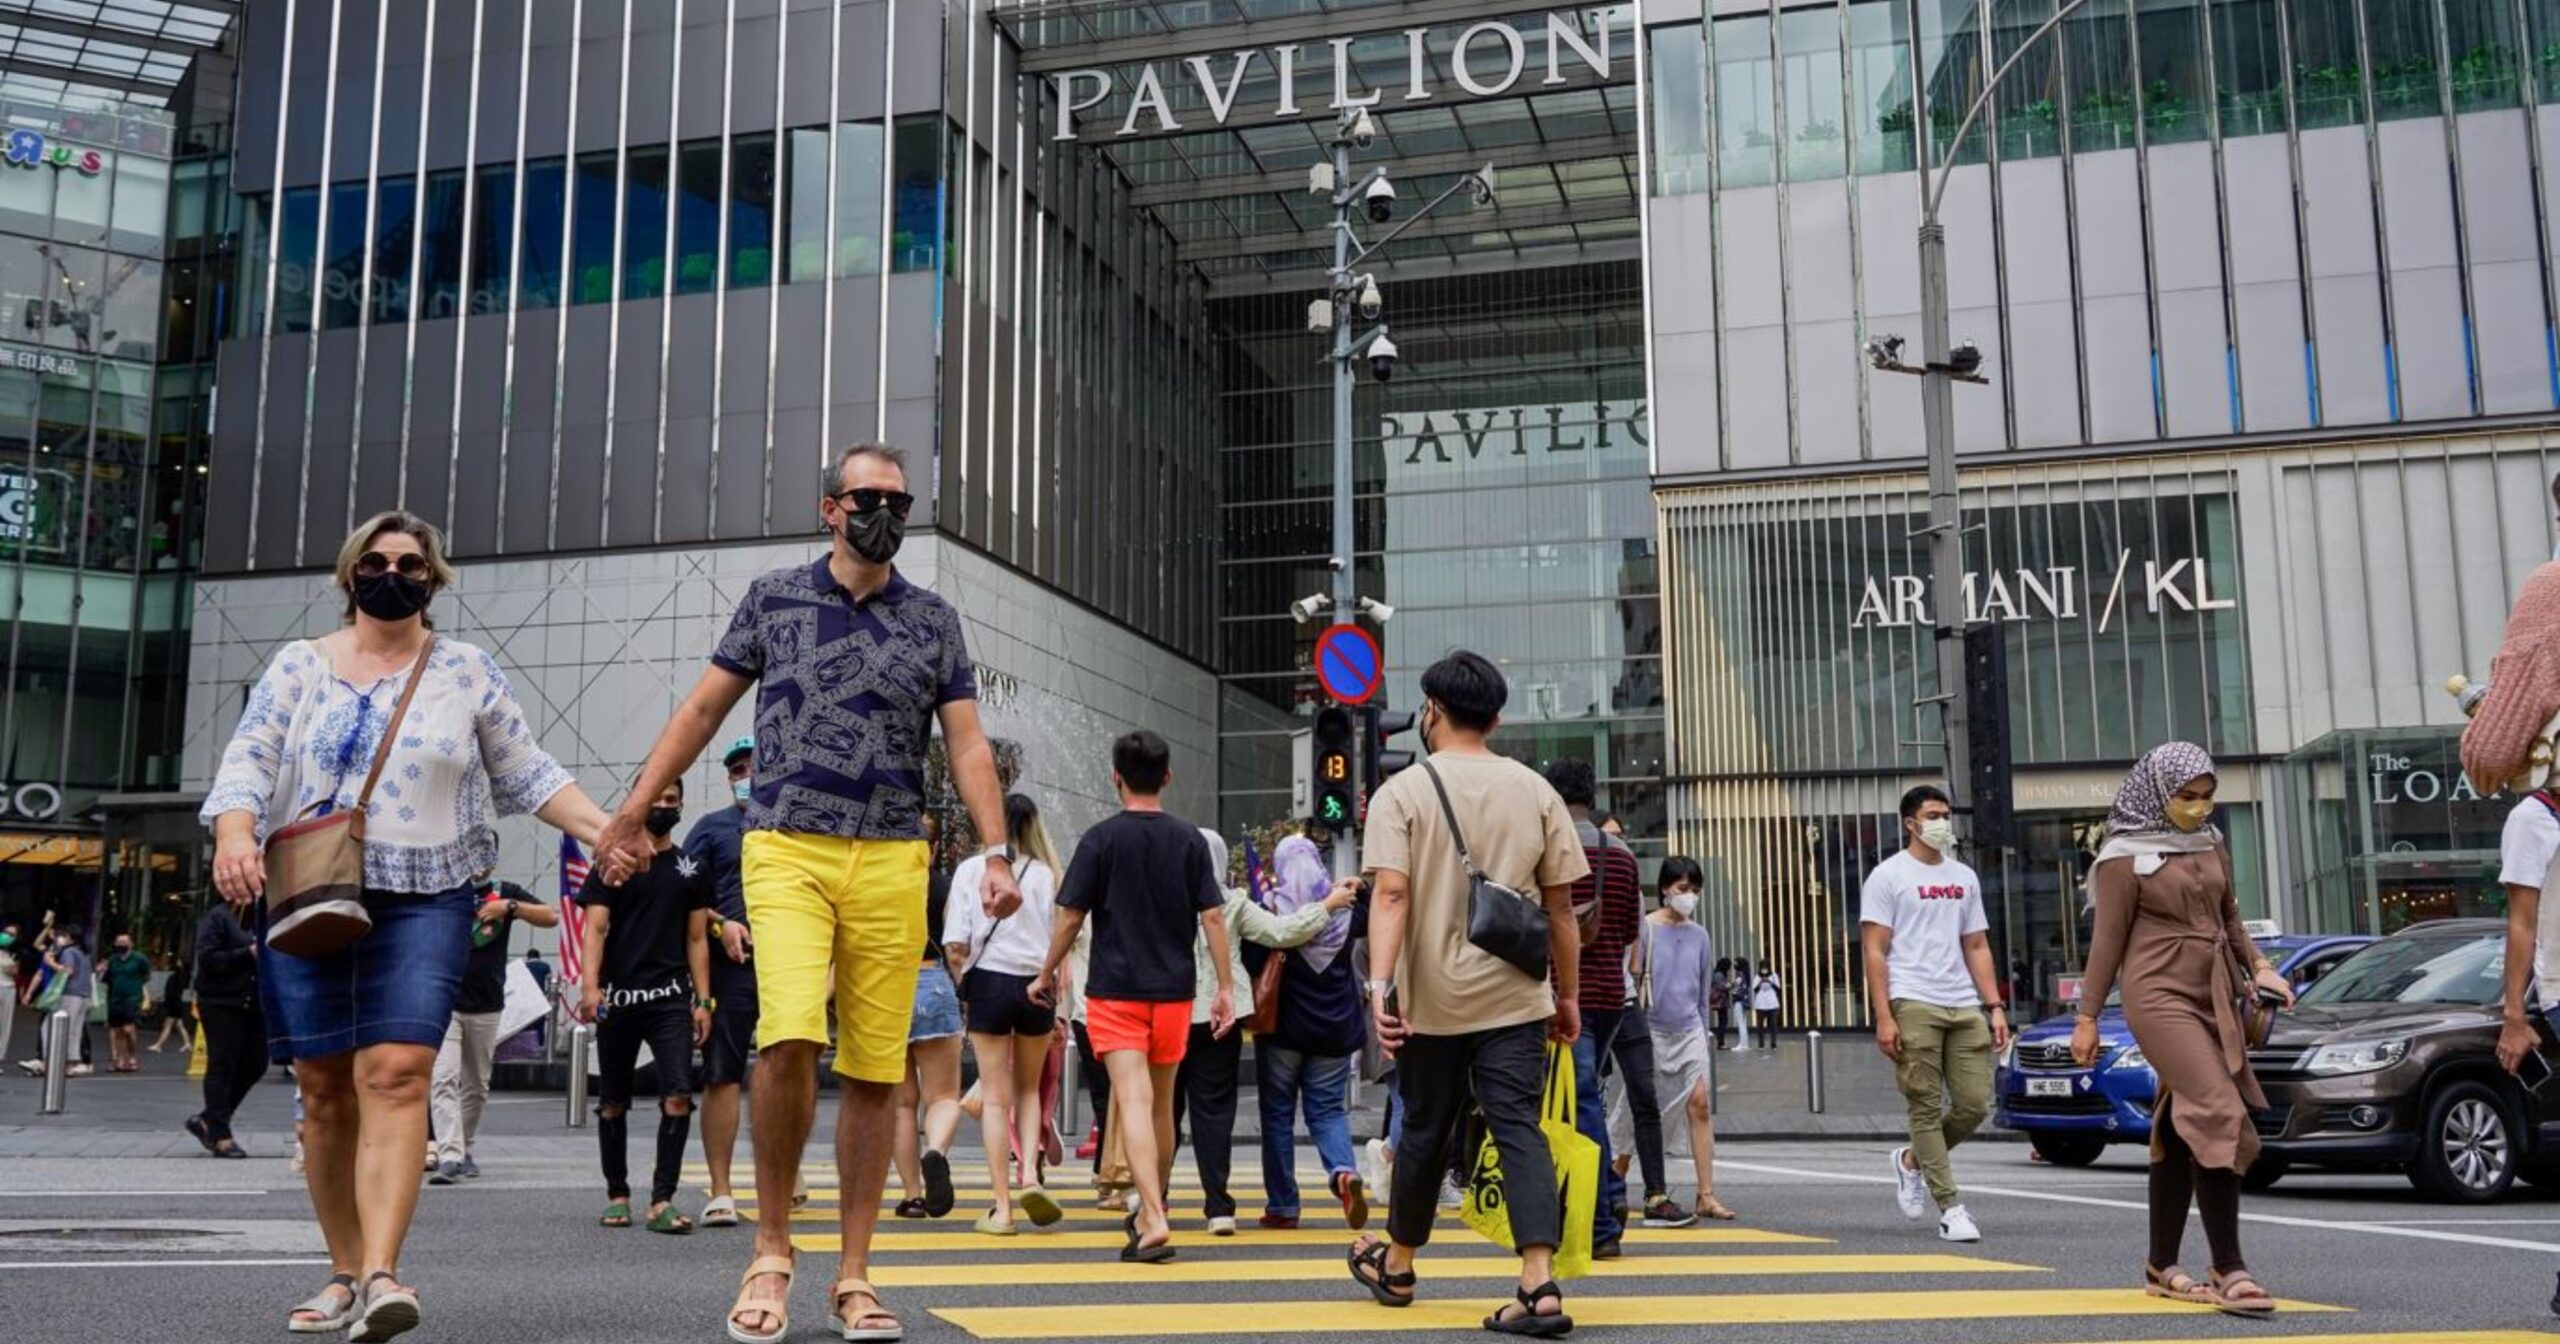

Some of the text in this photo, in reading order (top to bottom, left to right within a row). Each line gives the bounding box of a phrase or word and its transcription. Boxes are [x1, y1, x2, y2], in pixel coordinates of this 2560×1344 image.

[1052, 10, 1615, 141] PAVILION
[2145, 557, 2236, 613] KL
[1327, 754, 1346, 779] 13
[2370, 752, 2411, 771] The
[0, 781, 61, 818] O
[2371, 769, 2508, 804] LOA
